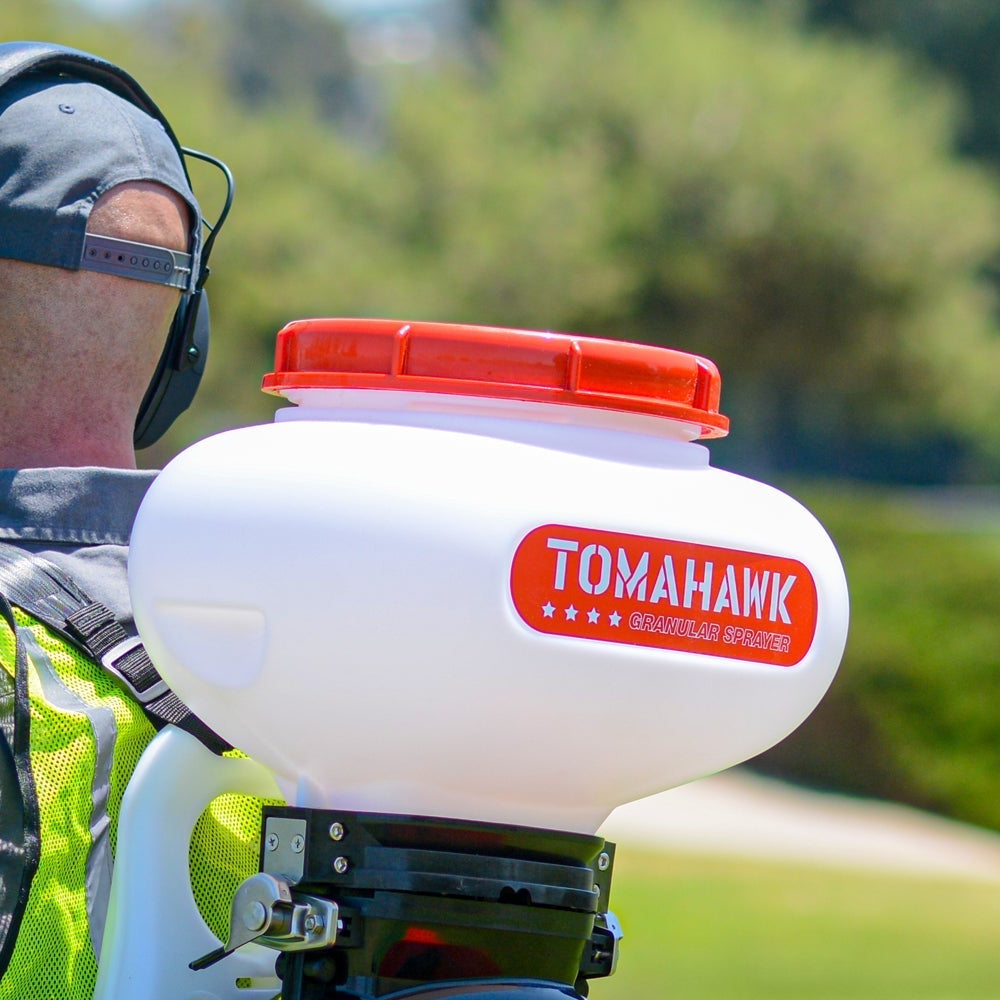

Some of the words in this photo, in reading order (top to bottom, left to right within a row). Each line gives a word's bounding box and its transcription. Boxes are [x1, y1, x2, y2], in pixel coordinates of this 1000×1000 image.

[547, 537, 797, 625] TOMAHAWK
[628, 611, 720, 642] GRANULAR
[722, 625, 790, 653] SPRAYER
